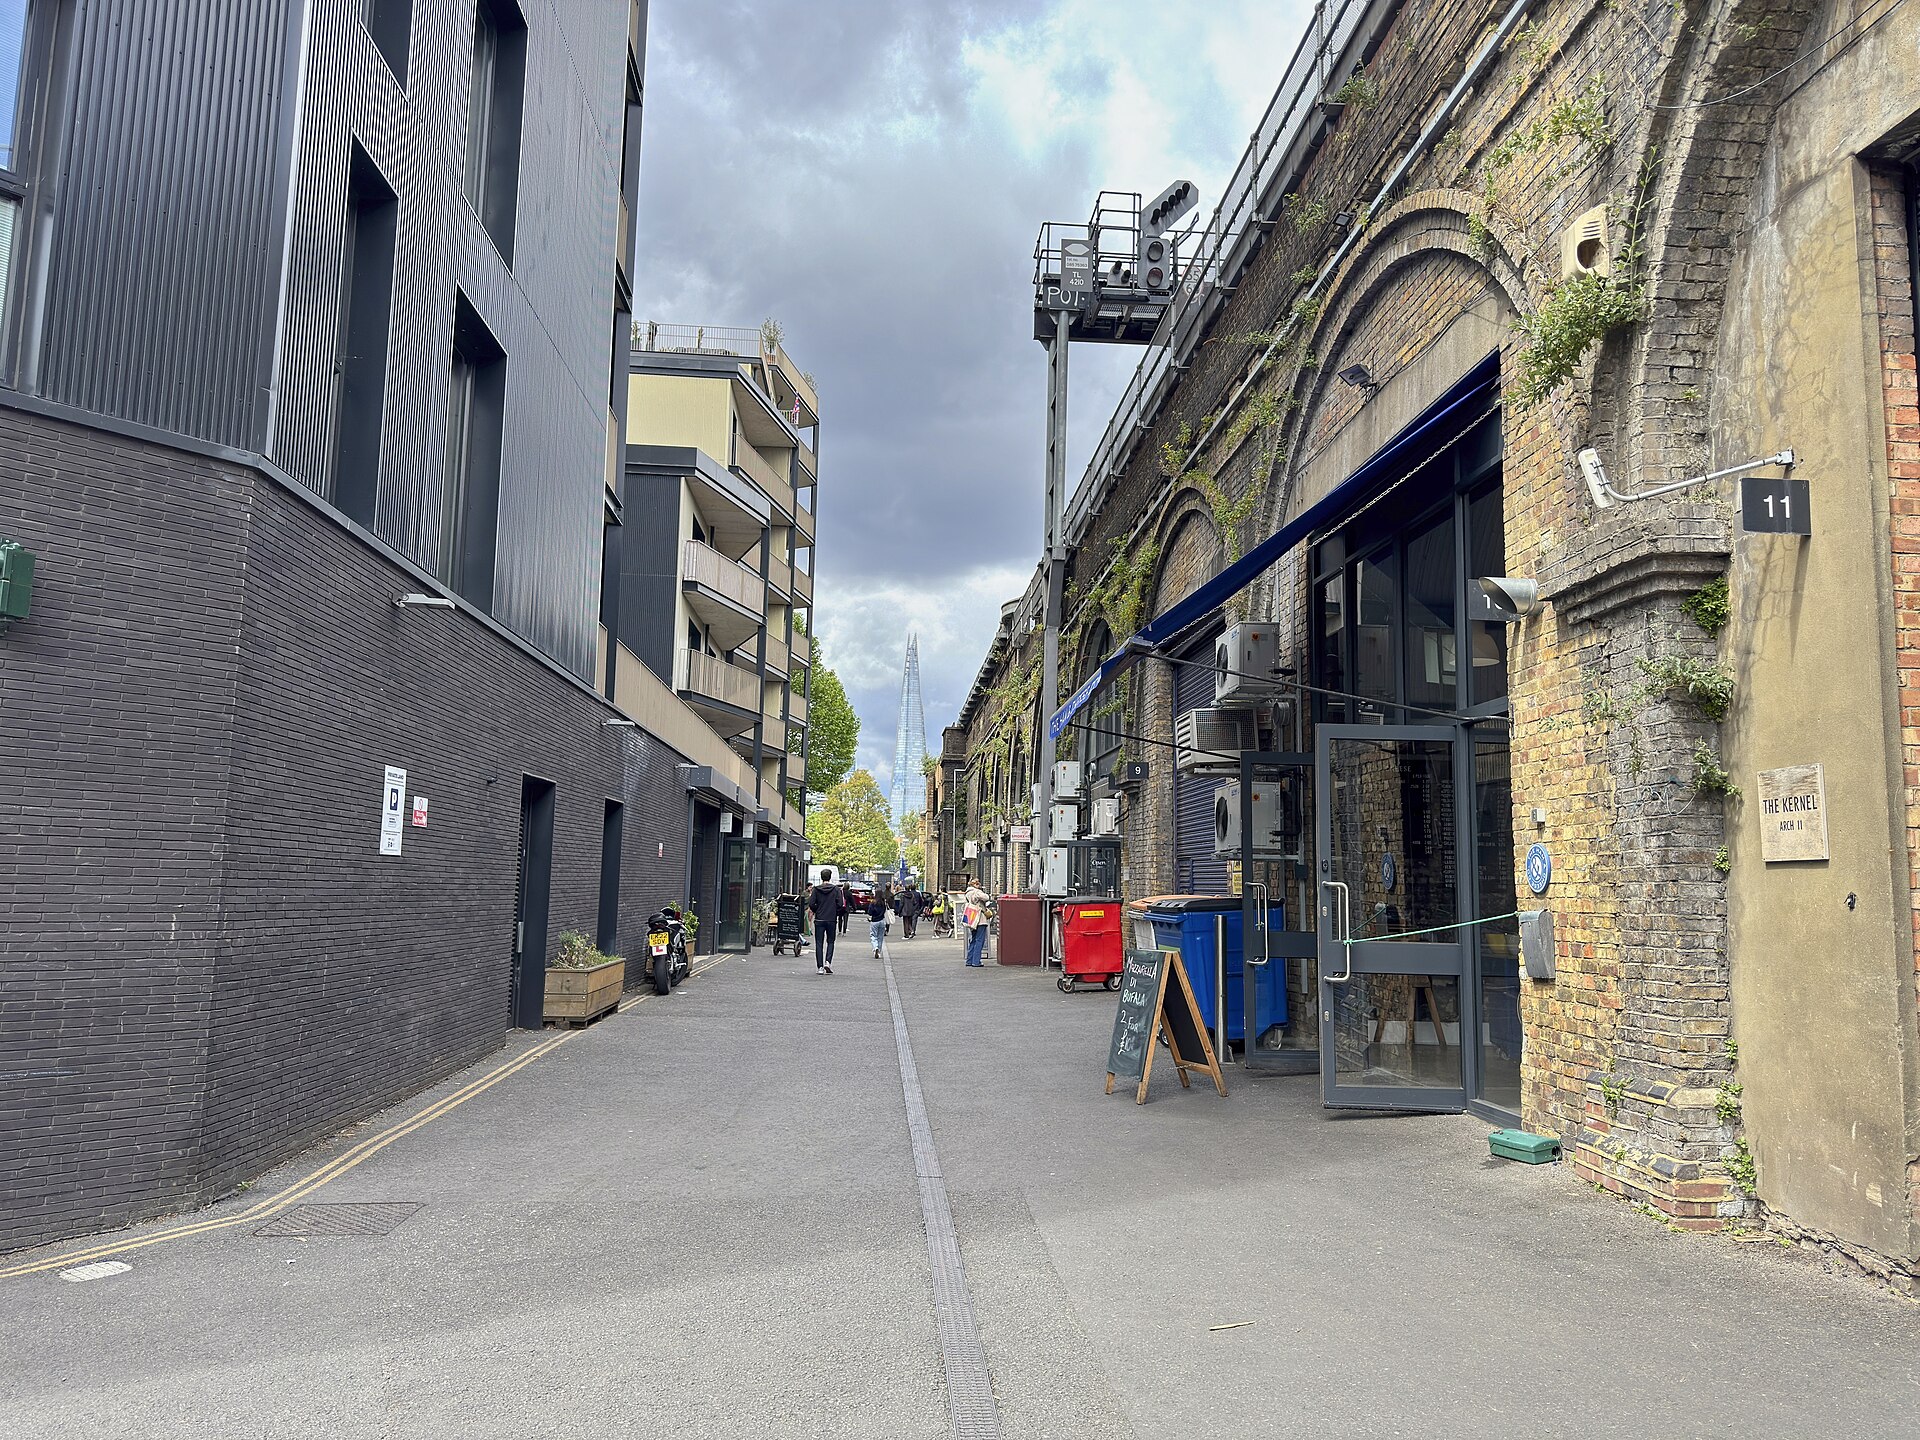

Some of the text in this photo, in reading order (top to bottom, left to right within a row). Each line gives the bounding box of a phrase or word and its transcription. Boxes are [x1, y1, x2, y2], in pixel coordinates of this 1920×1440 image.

[1072, 271, 1082, 279] TL
[1069, 278, 1085, 286] 4210
[1763, 494, 1791, 519] 11
[1135, 766, 1142, 775] 9
[1763, 794, 1818, 814] THE KERNEL
[1779, 820, 1803, 832] ARCH 11
[1129, 976, 1137, 988] DI
[1120, 1009, 1127, 1024] 2
